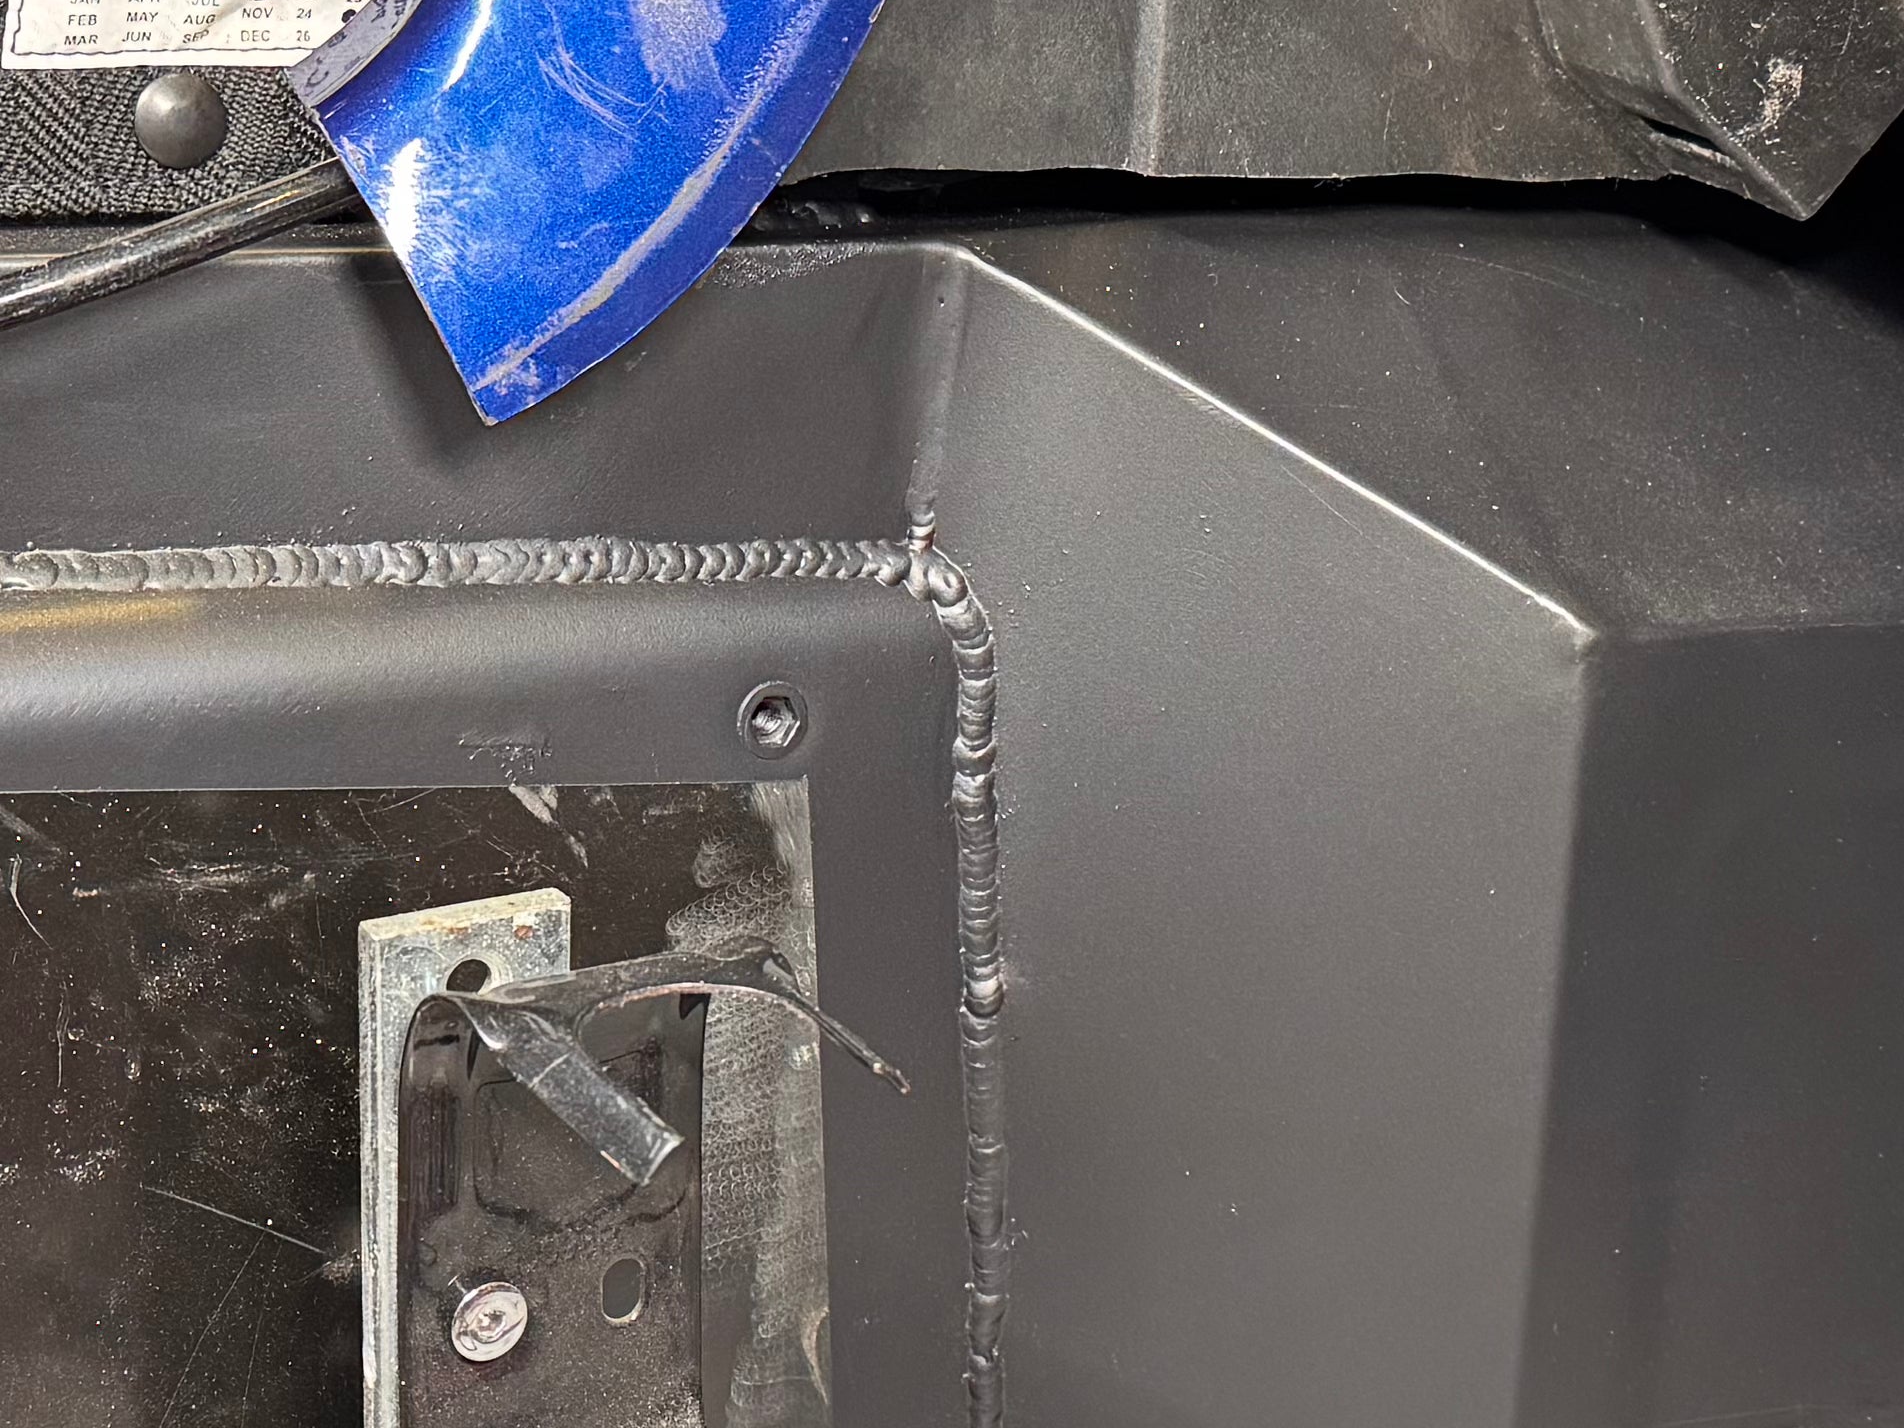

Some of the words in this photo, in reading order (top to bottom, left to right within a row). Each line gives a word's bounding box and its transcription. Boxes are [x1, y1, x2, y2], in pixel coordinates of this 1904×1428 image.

[67, 14, 97, 26] FEB
[126, 12, 159, 23] MAY
[183, 14, 216, 25] AUG
[241, 6, 274, 19] NOV
[296, 8, 312, 19] 24
[64, 34, 98, 46] MAR
[121, 31, 152, 43] JUN
[182, 29, 210, 44] SEP
[240, 30, 271, 42] DEC
[296, 30, 311, 42] 26
